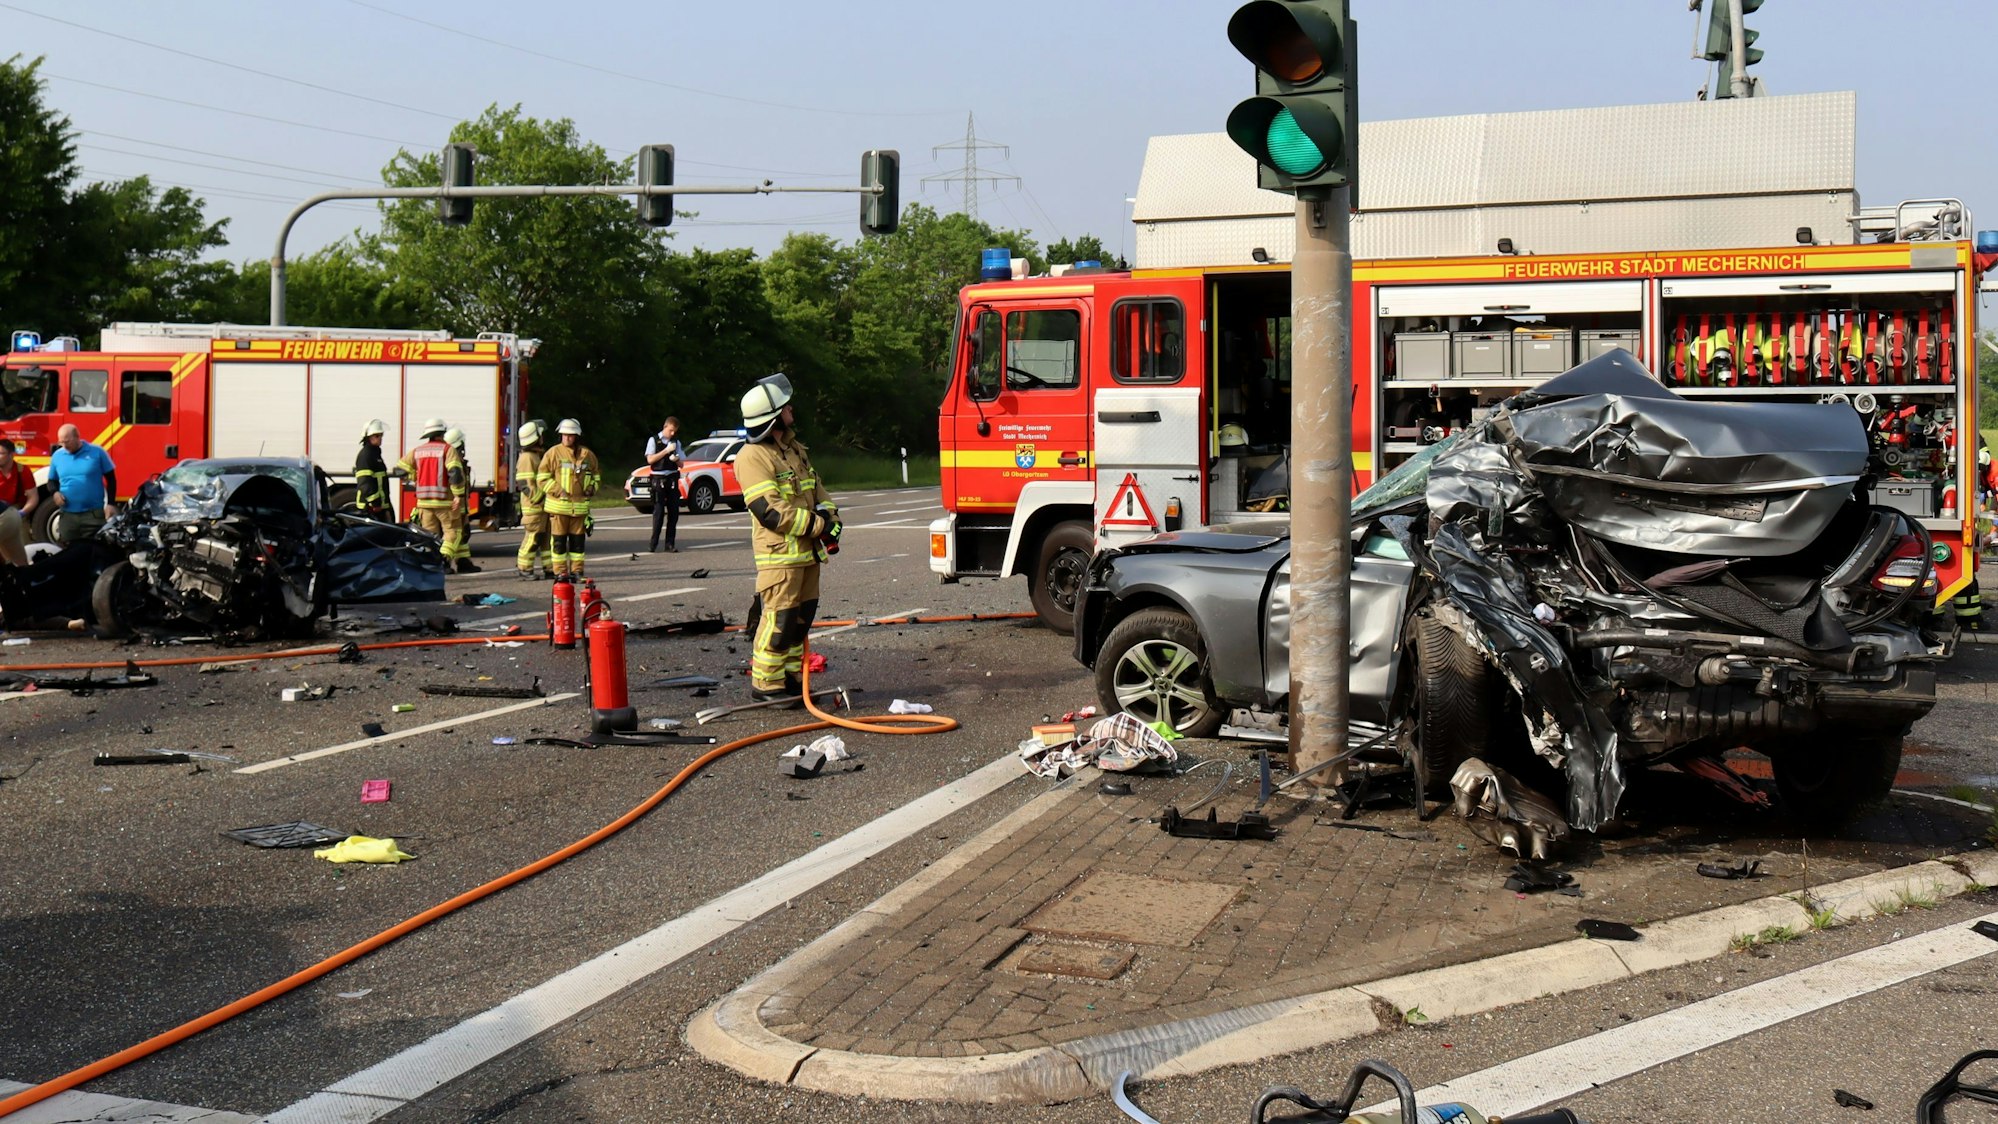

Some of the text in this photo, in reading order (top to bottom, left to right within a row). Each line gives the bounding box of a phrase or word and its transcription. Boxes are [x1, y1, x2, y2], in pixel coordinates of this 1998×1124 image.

[1504, 254, 1805, 278] FEUERWEHR STADT MECHERNICH
[283, 341, 426, 360] FEUERWEHR 112
